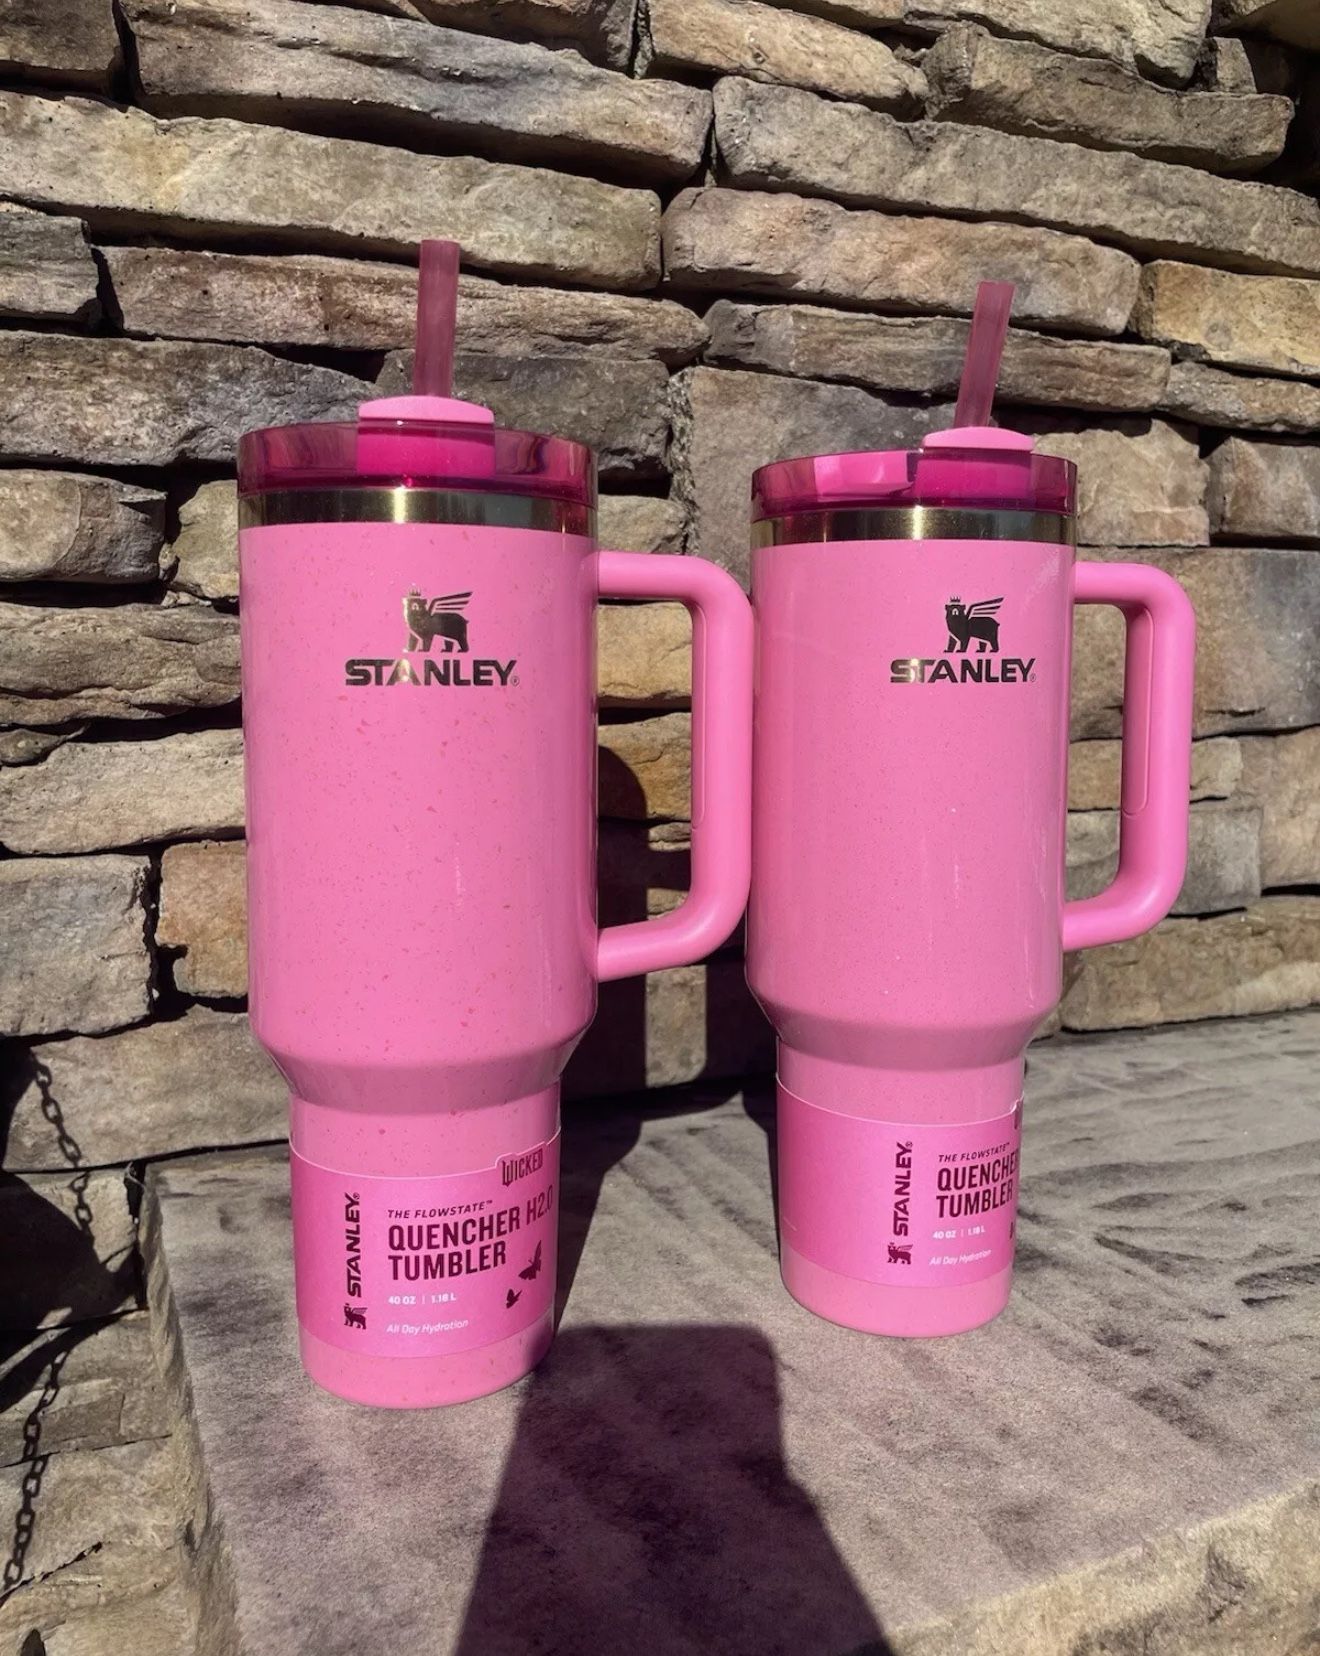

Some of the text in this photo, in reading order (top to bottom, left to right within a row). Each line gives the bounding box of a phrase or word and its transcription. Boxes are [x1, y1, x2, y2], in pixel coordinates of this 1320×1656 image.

[938, 1154, 956, 1162] THE
[502, 1148, 543, 1187] WICKED
[936, 1178, 1013, 1218] TUMBLER
[387, 1210, 410, 1219] THE
[388, 1206, 520, 1251] QUENCHER
[933, 1231, 944, 1239] 40
[945, 1230, 957, 1239] OZ
[388, 1240, 506, 1281] TUMBLER
[929, 1256, 942, 1265] All
[943, 1256, 958, 1266] Day
[388, 1292, 457, 1305] 40 OZ 1.18 L
[386, 1319, 469, 1336] All Day Hydration
